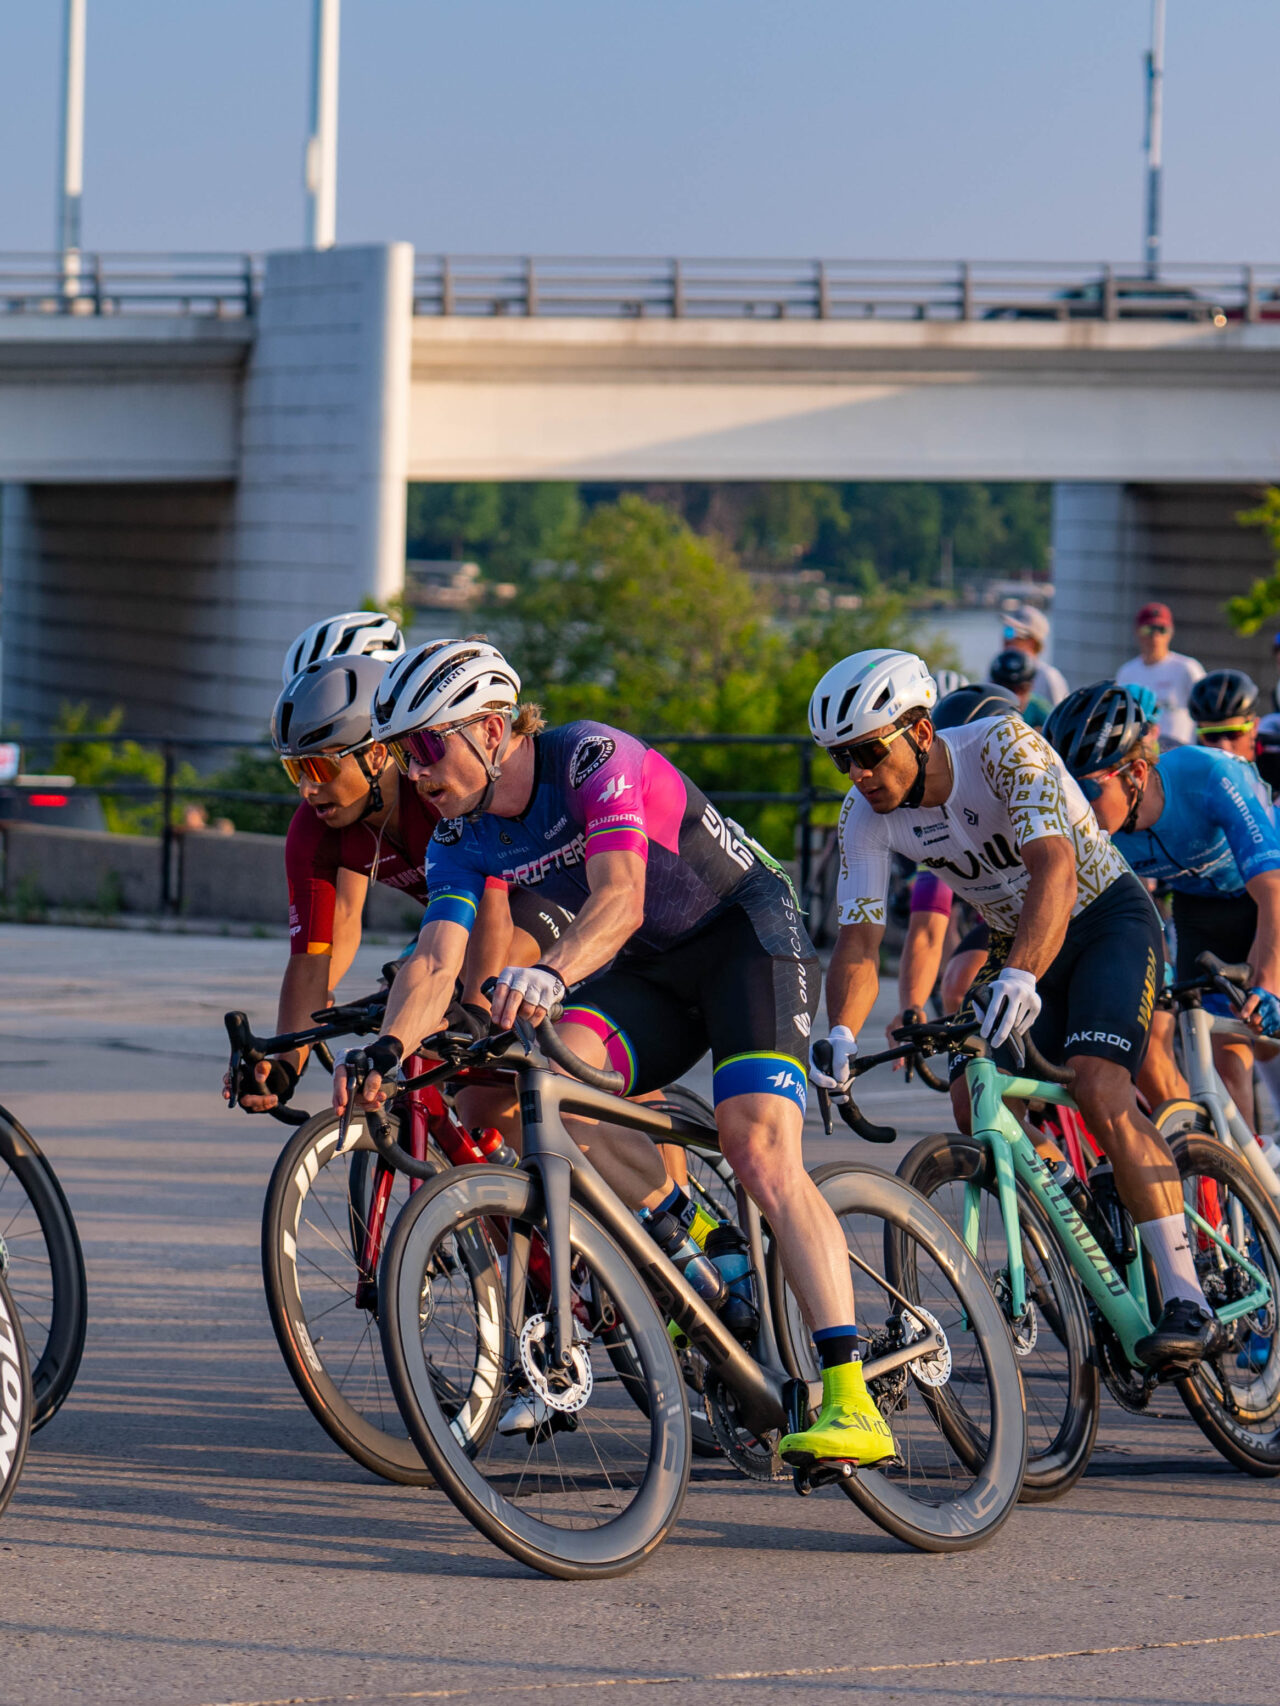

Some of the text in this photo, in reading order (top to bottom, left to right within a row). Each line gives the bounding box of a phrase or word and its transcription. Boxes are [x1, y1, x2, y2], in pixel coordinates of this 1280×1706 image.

[437, 667, 466, 693] GIRO
[588, 812, 644, 830] SHIMANO
[1220, 777, 1264, 844] SHIMANO
[543, 814, 569, 840] GARMIN
[1063, 1031, 1132, 1052] JAKROO
[1021, 1150, 1129, 1297] SPECIALIZED
